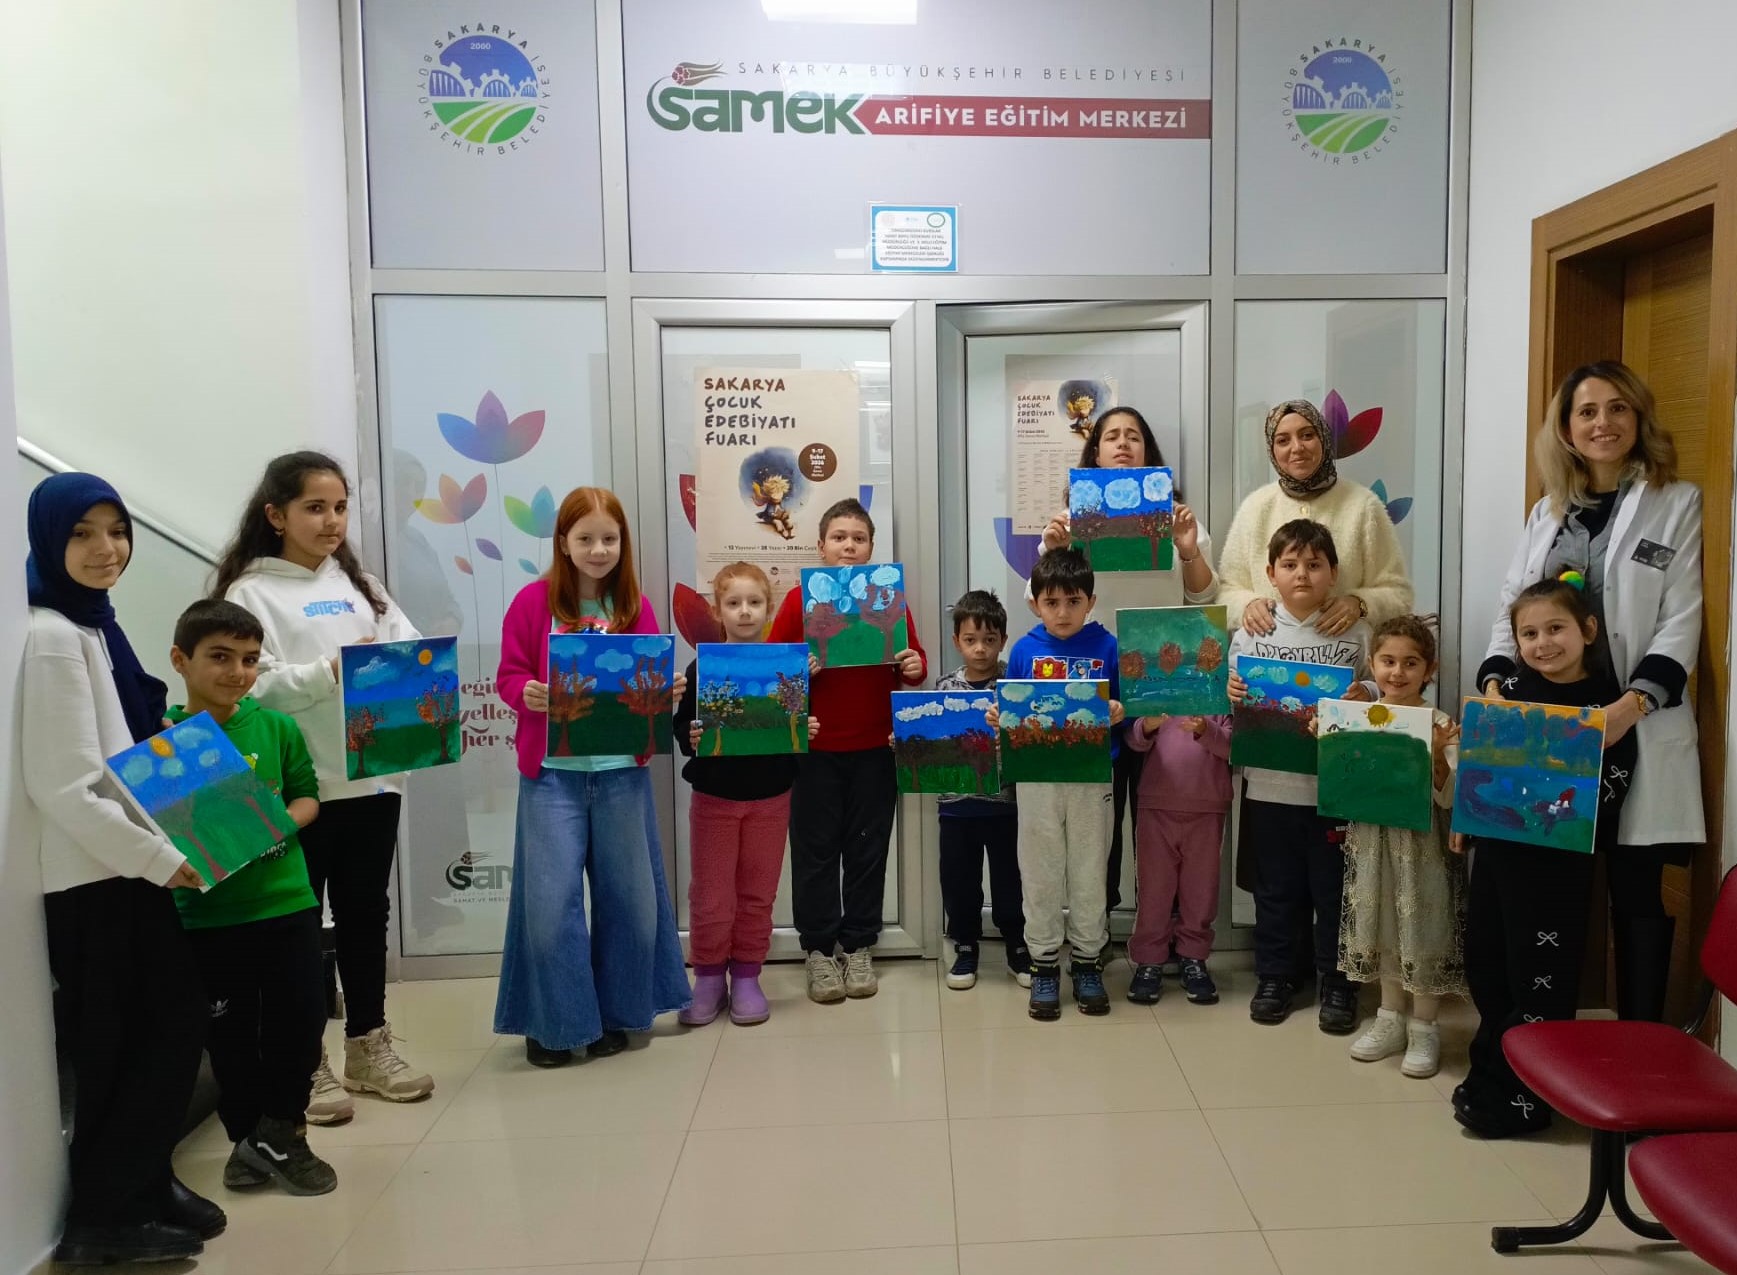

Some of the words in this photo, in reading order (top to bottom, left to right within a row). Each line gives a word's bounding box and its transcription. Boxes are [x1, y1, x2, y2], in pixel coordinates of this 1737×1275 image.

[434, 22, 528, 50] SAKARYA
[1300, 37, 1386, 64] SAKARYA
[738, 62, 848, 76] SAKARYA
[869, 62, 1023, 80] BÜYÜKŞEHİR
[1043, 67, 1185, 82] BELEDİYESİ
[874, 103, 975, 126] ARİFİYE
[985, 104, 1069, 128] EĞİTİM
[1079, 106, 1187, 129] MERKEZİ
[704, 377, 786, 392] SAKARYA
[704, 394, 763, 413] ÇOCUK
[704, 413, 797, 430] EDEBİYATI
[704, 431, 757, 447] FUARI
